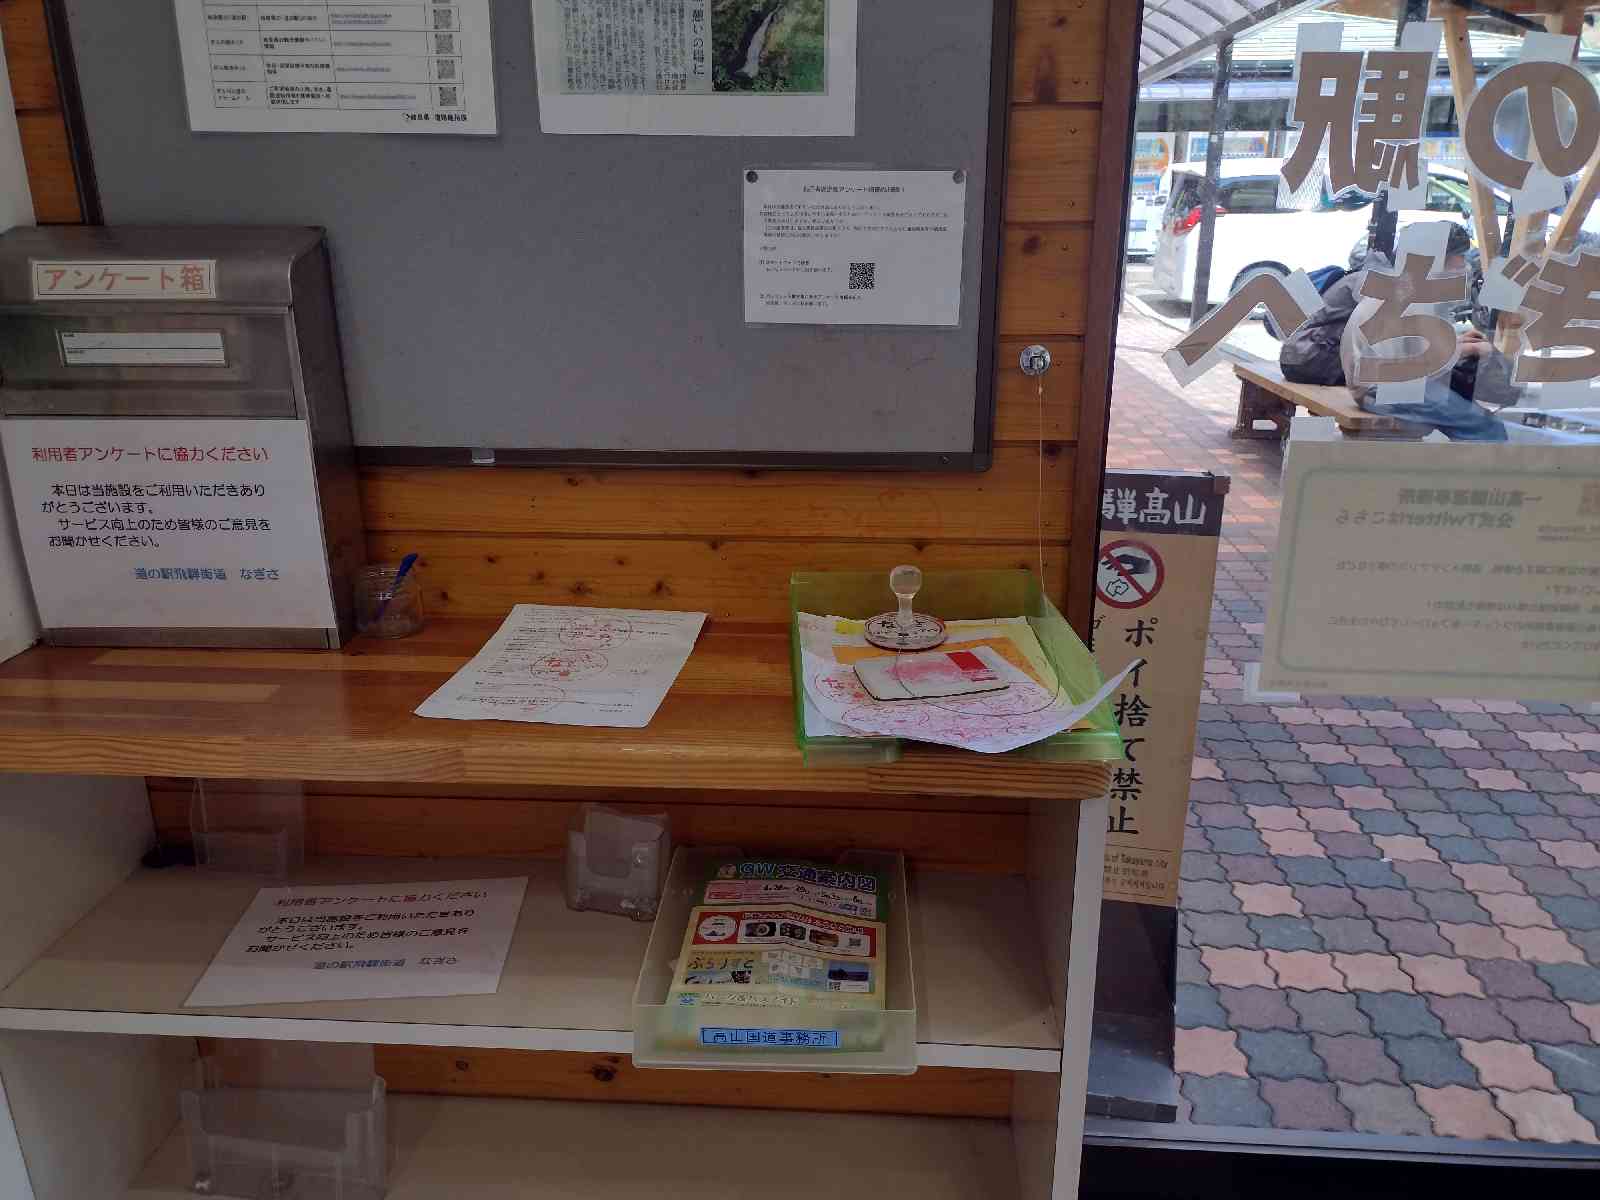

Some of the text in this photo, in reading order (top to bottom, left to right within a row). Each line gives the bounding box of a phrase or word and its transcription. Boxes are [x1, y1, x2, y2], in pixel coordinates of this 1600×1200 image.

[44, 267, 206, 292] アンケート箱
[32, 446, 268, 463] 利用者アンケートに協力ください
[51, 483, 265, 498] 本日は当施設をご利用いただきあり
[41, 501, 154, 514] がとうございます。
[58, 518, 271, 532] サービス向上のため皆様のご意見を
[49, 535, 160, 548] お聞かせください。
[1107, 617, 1158, 835] ポイ捨て禁止
